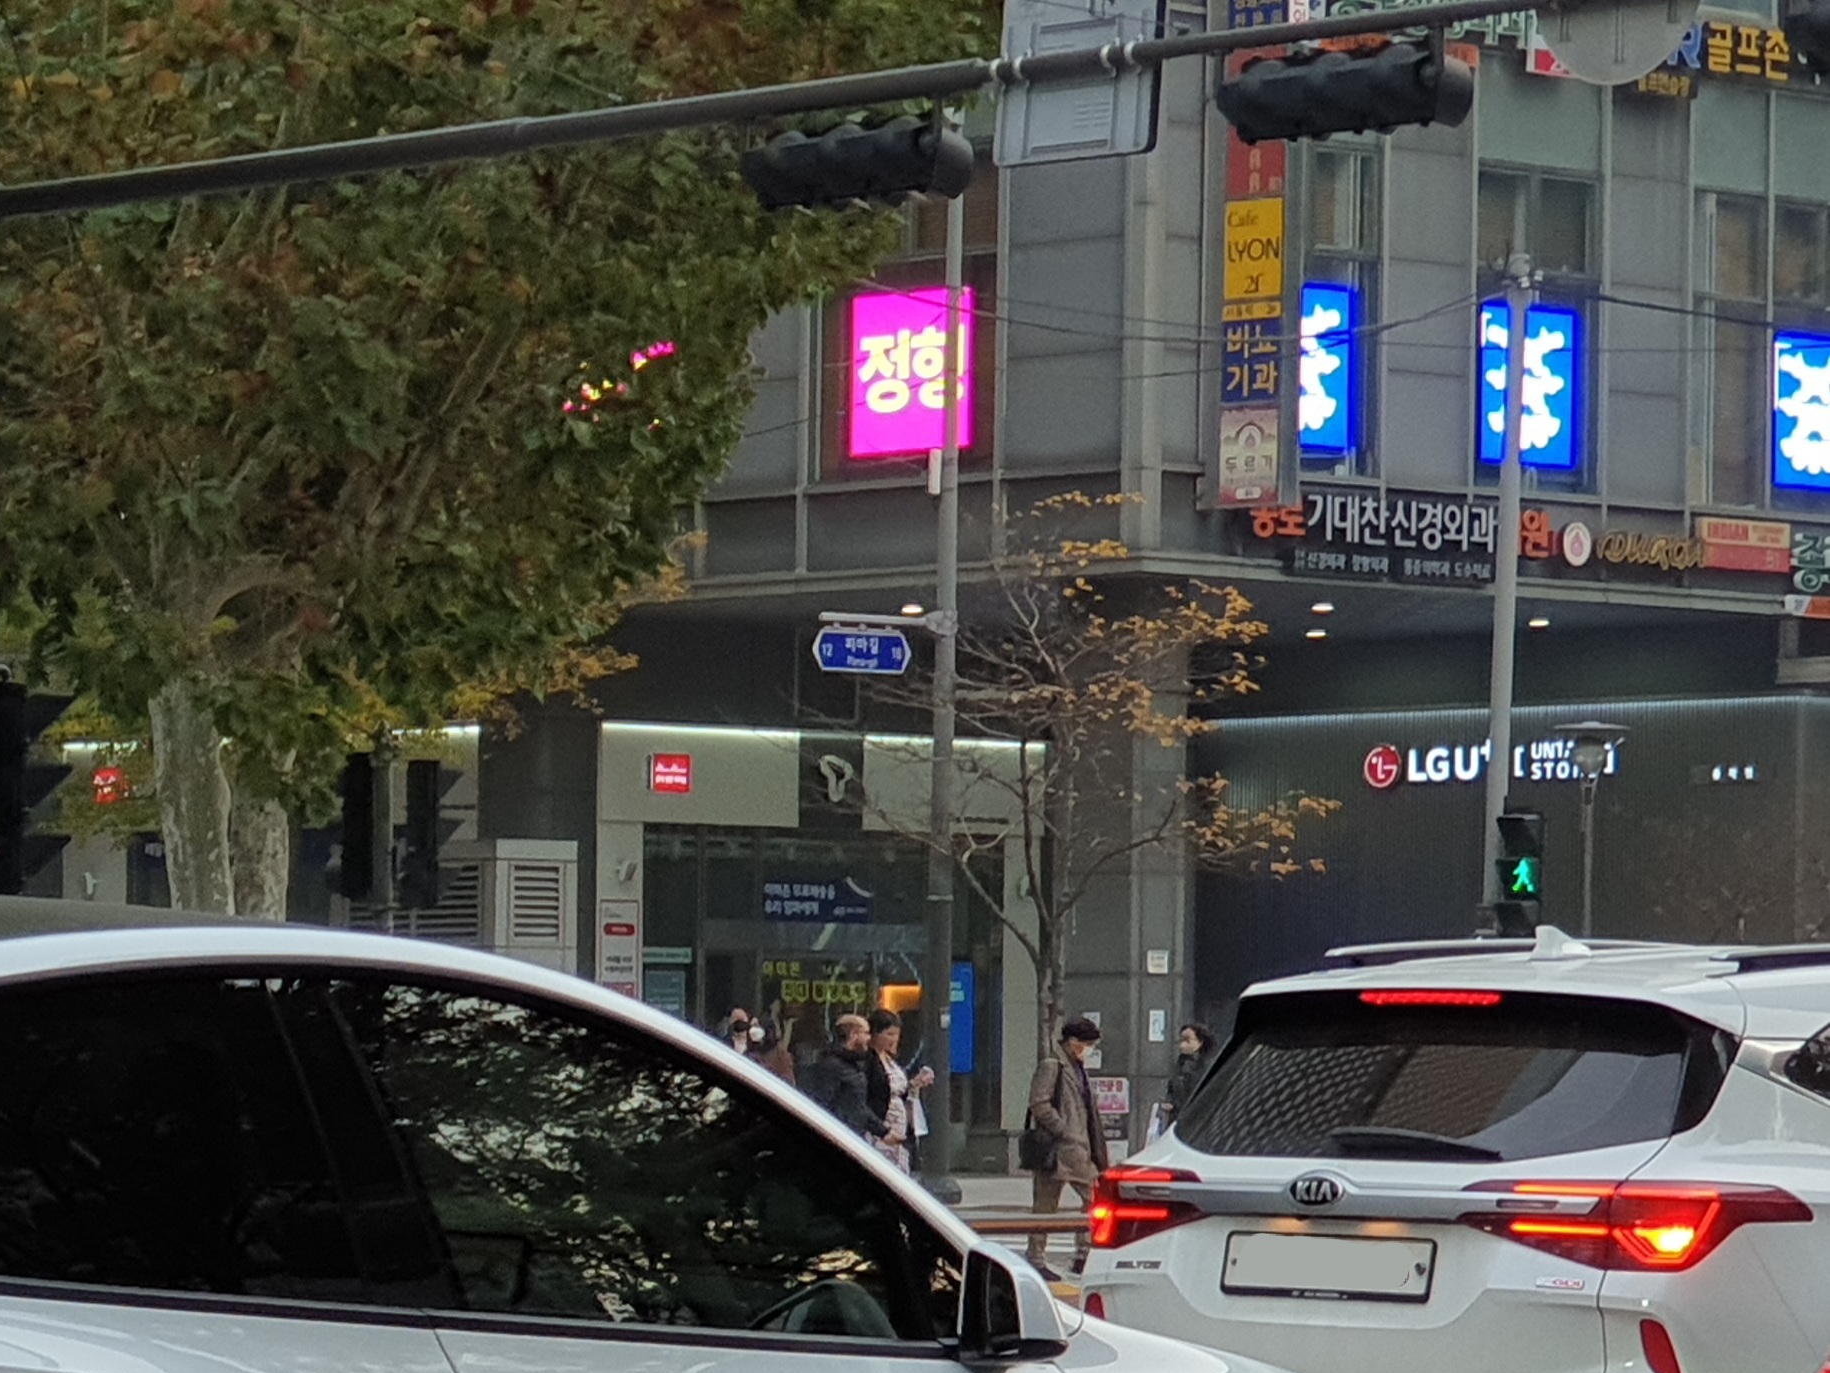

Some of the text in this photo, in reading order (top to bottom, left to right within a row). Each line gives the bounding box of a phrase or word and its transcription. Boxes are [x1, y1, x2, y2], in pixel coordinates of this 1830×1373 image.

[1707, 20, 1791, 81] 골프존
[1228, 236, 1281, 262] LYON
[1227, 324, 1278, 359] 비뇨
[1227, 360, 1278, 398] 기과
[1294, 1181, 1334, 1203] KIA
